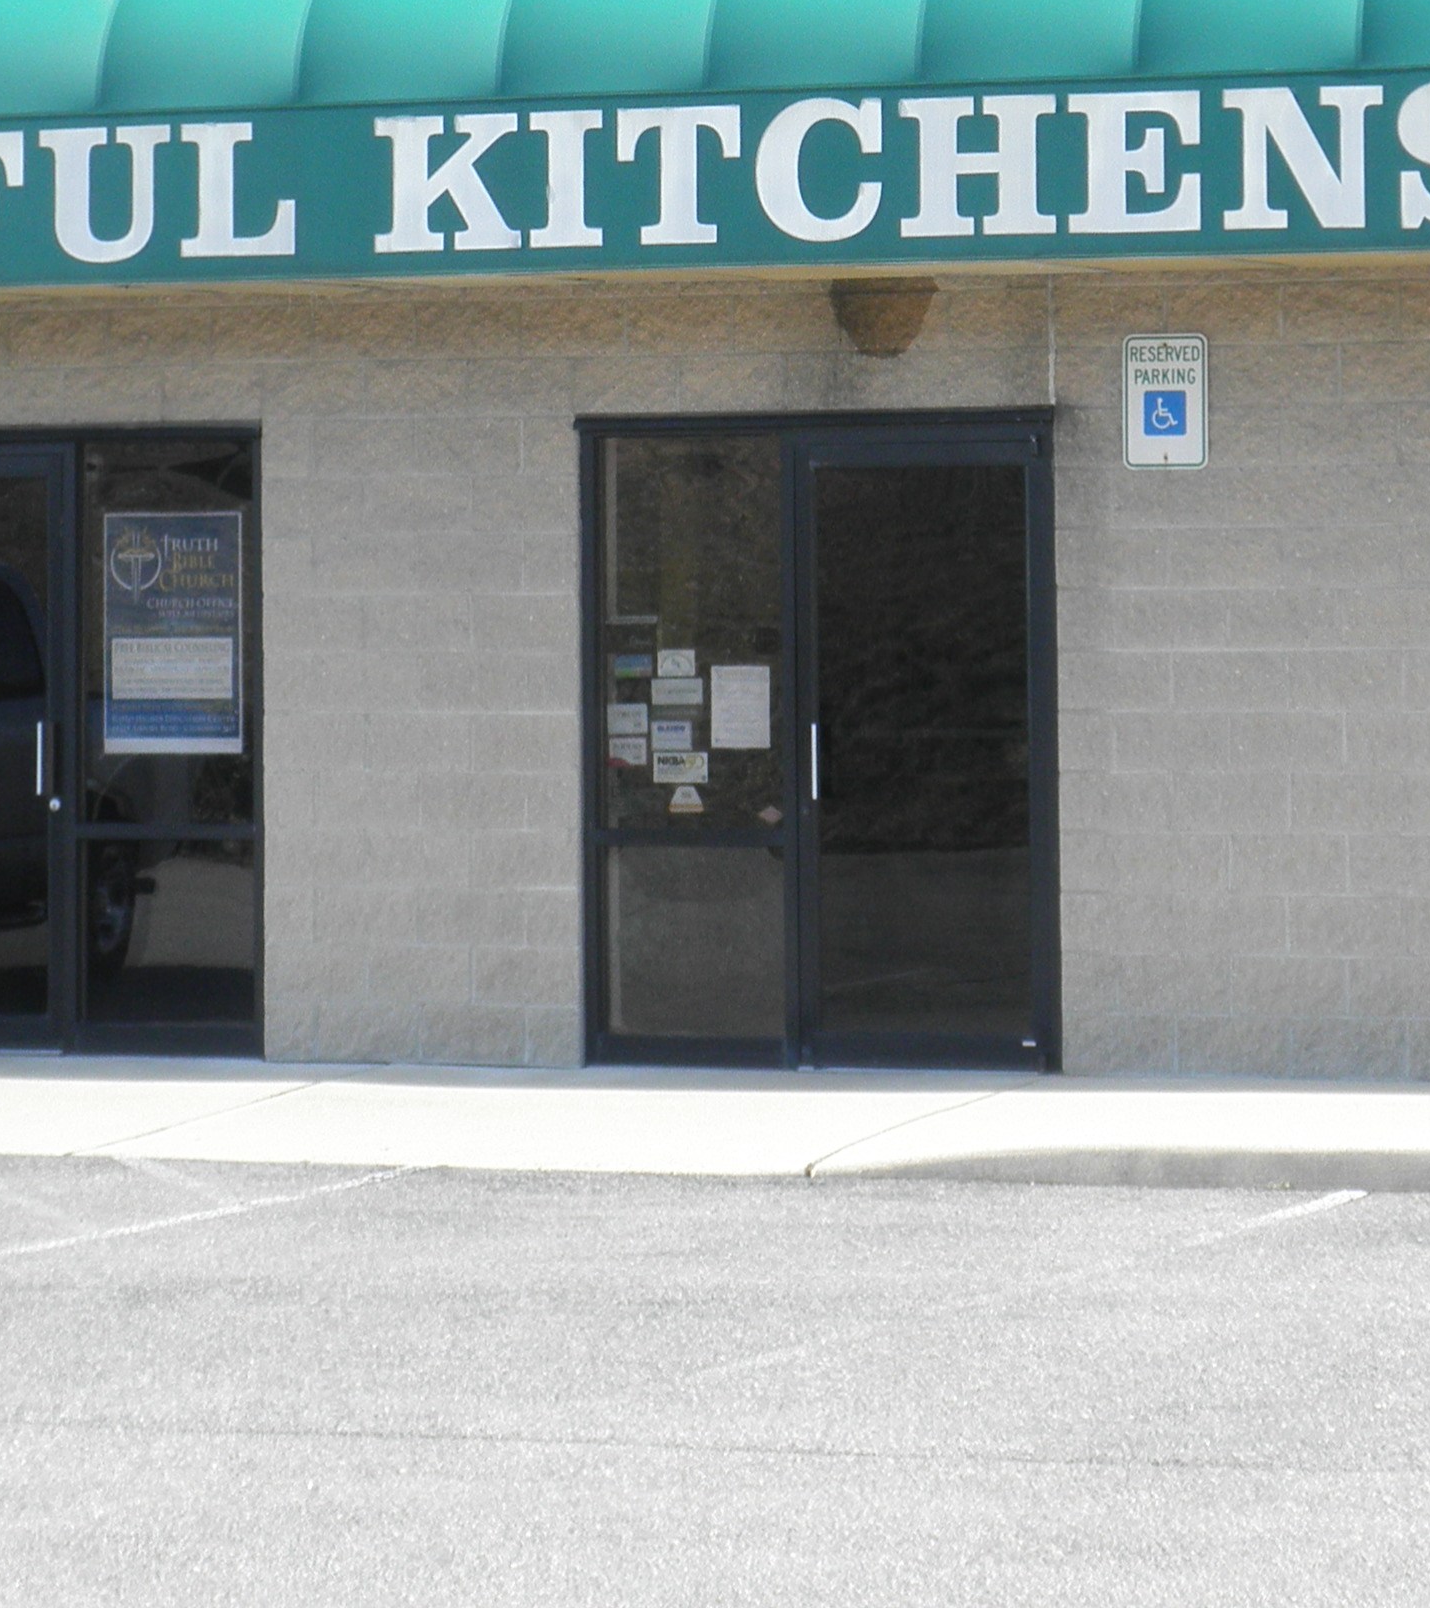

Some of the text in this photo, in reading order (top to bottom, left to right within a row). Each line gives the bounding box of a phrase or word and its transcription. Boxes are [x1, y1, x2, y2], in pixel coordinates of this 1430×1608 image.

[1129, 345, 1201, 363] RESERVED
[1134, 368, 1197, 385] PARKING
[173, 552, 215, 572] BIBLE
[158, 570, 234, 591] CHURCH
